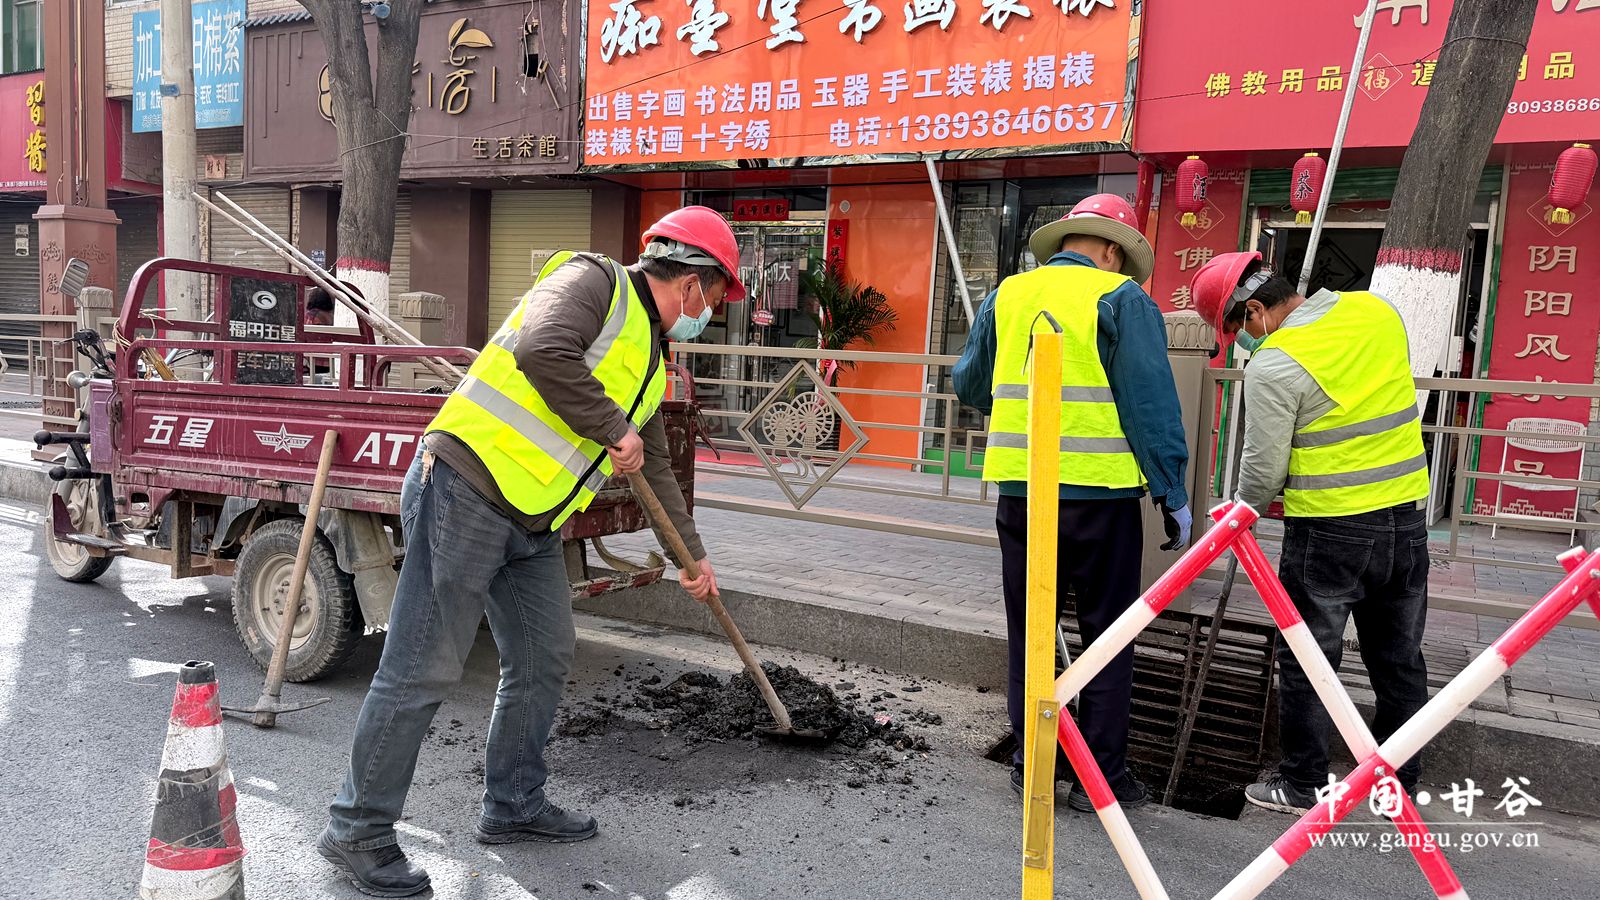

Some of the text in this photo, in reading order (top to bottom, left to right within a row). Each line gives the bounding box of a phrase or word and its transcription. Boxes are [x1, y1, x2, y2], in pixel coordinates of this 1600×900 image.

[588, 51, 1095, 121] 出售字画 书法用品 玉器 手工装裱 揭裱
[1205, 65, 1343, 98] 佛教用品
[472, 134, 556, 158] 生活茶館
[586, 119, 771, 157] 装裱钻画 十字绣
[143, 415, 214, 448] 五星
[352, 431, 424, 466] AT
